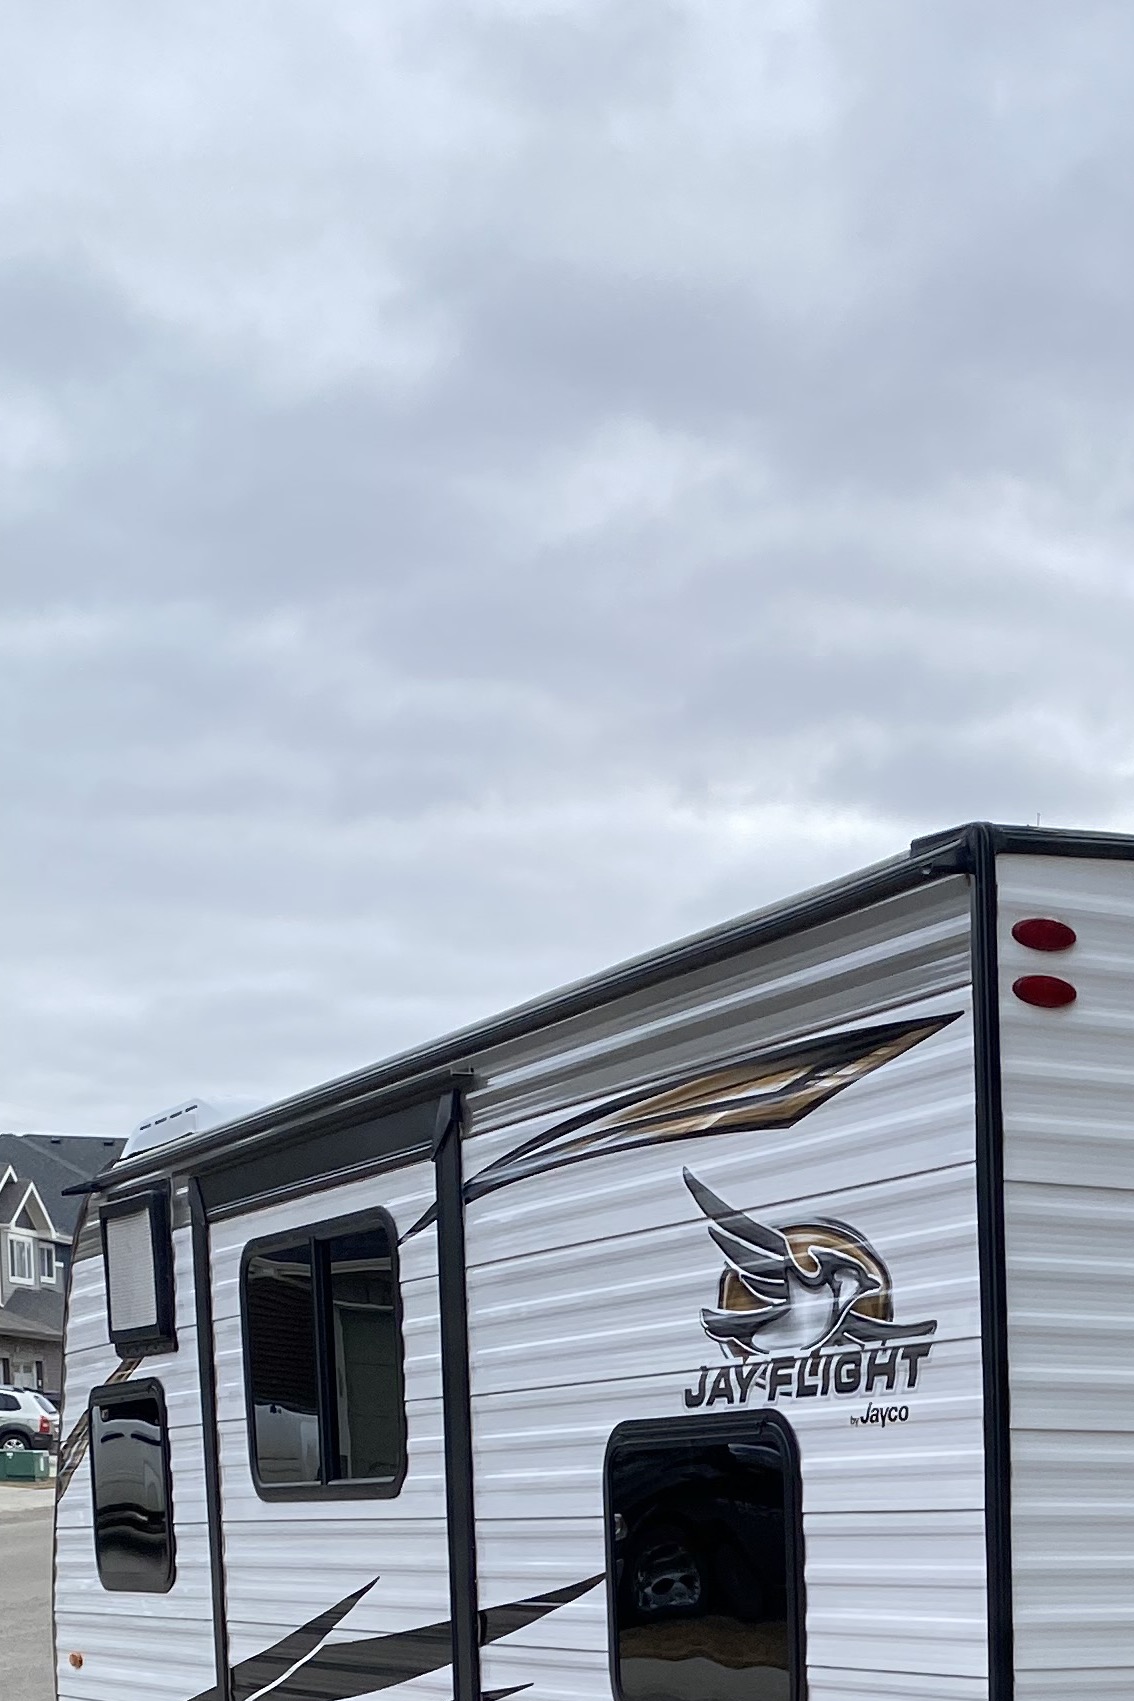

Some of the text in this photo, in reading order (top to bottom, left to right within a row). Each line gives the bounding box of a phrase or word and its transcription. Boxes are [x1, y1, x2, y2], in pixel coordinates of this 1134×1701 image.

[684, 1343, 933, 1408] JAY FLIGHT
[860, 1402, 909, 1428] Jayco
